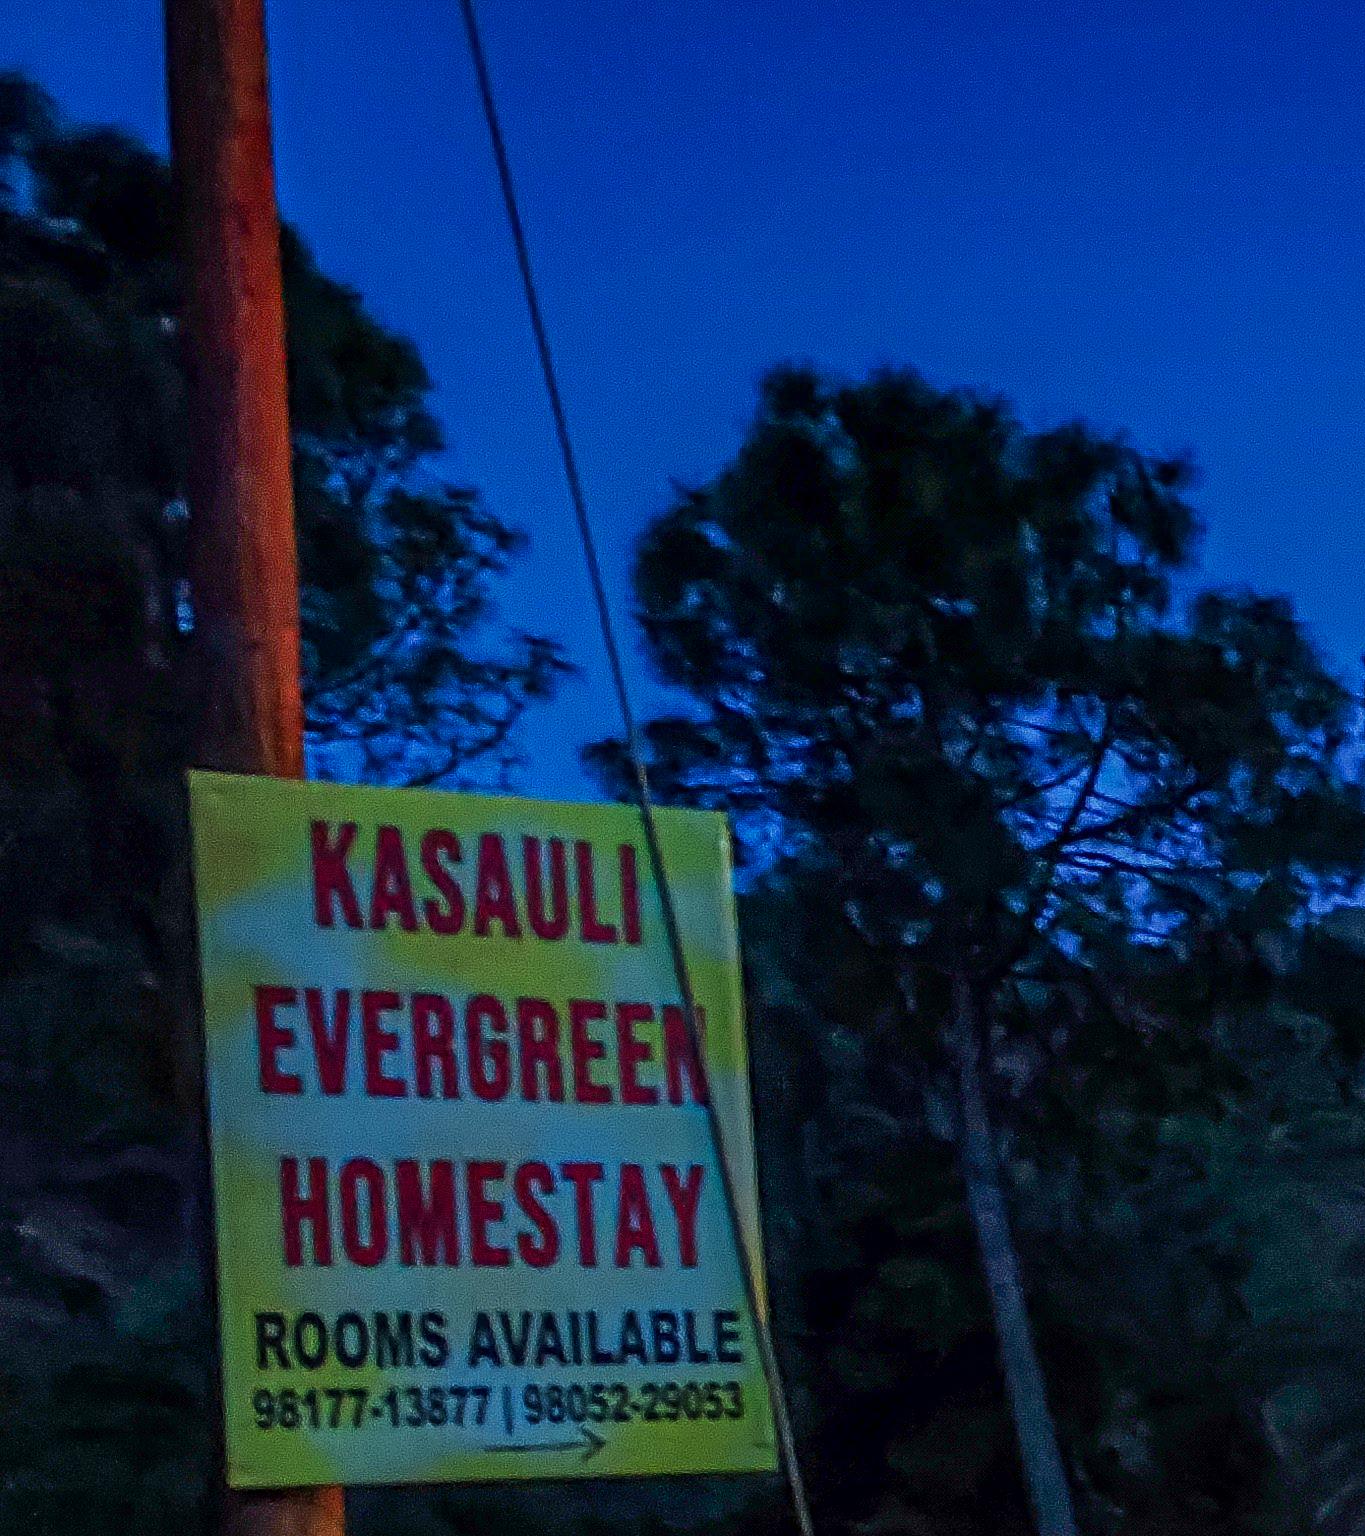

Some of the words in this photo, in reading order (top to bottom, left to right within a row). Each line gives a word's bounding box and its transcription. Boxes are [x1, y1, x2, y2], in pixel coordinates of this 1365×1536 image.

[310, 820, 642, 945] KASAULI
[254, 985, 708, 1106] EVERGREEN
[279, 1157, 705, 1268] HOMESTAY
[255, 1311, 449, 1369] ROOMS
[467, 1309, 742, 1366] AVAILABLE
